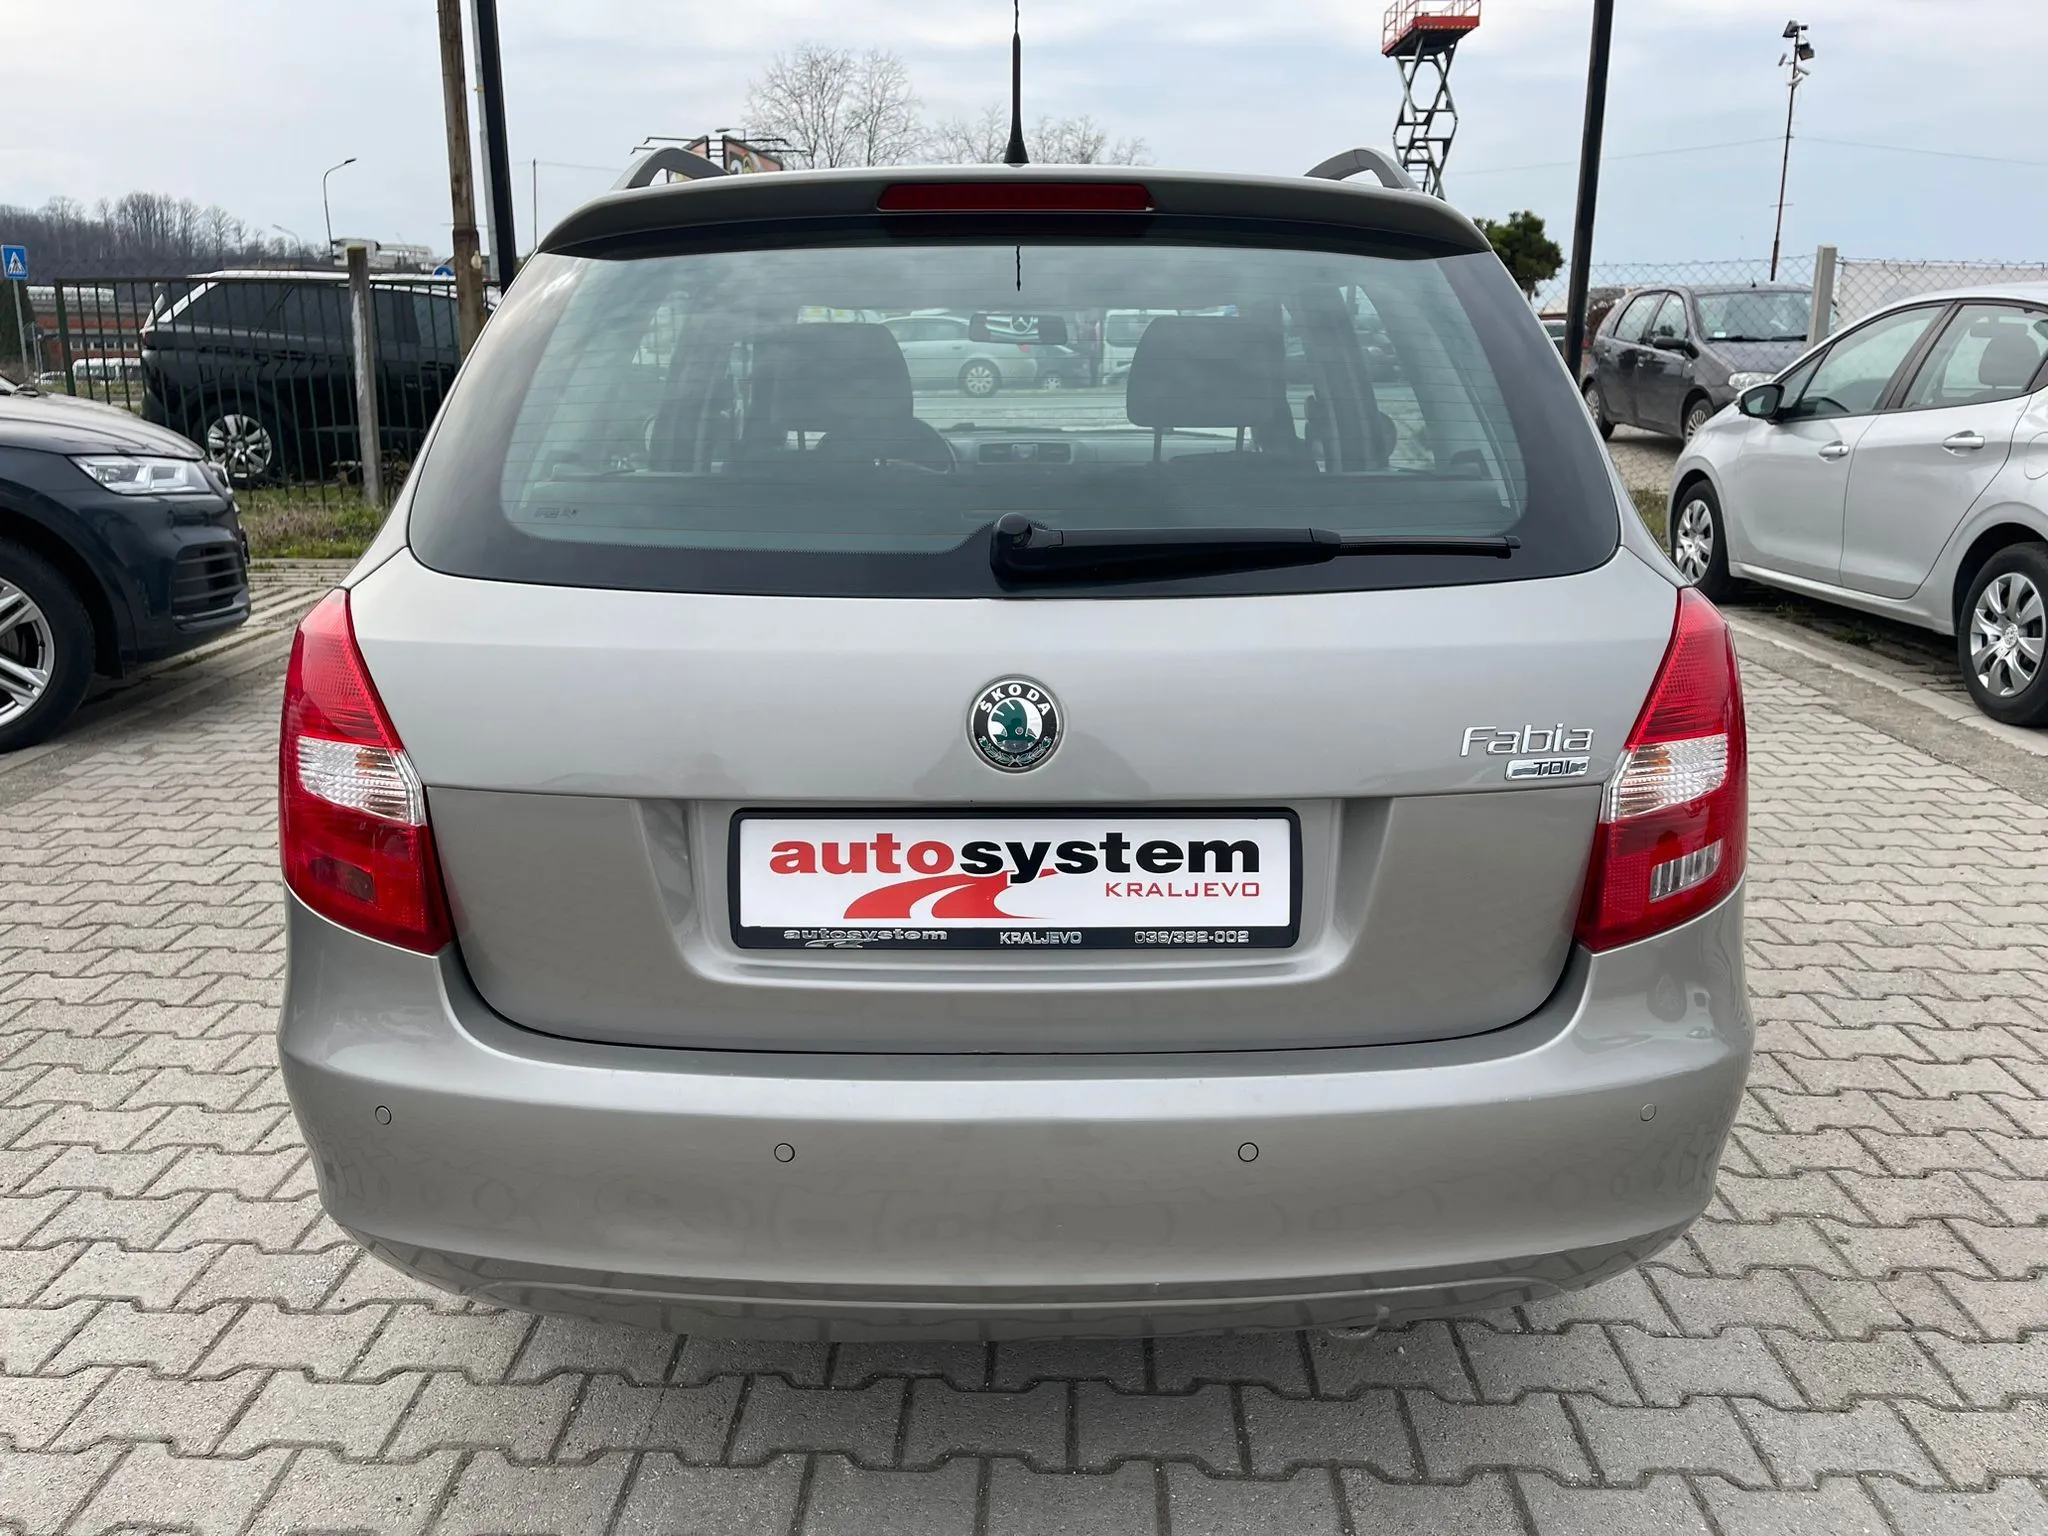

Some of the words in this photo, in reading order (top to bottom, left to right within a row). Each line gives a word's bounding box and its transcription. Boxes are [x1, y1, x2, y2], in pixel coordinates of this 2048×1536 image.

[1459, 722, 1595, 757] Fabia
[1533, 760, 1571, 776] TDI
[769, 832, 1260, 884] autosystem
[1105, 882, 1261, 898] KRALJEVO
[783, 928, 948, 942] autosystem
[999, 931, 1082, 944] KRALJEVO
